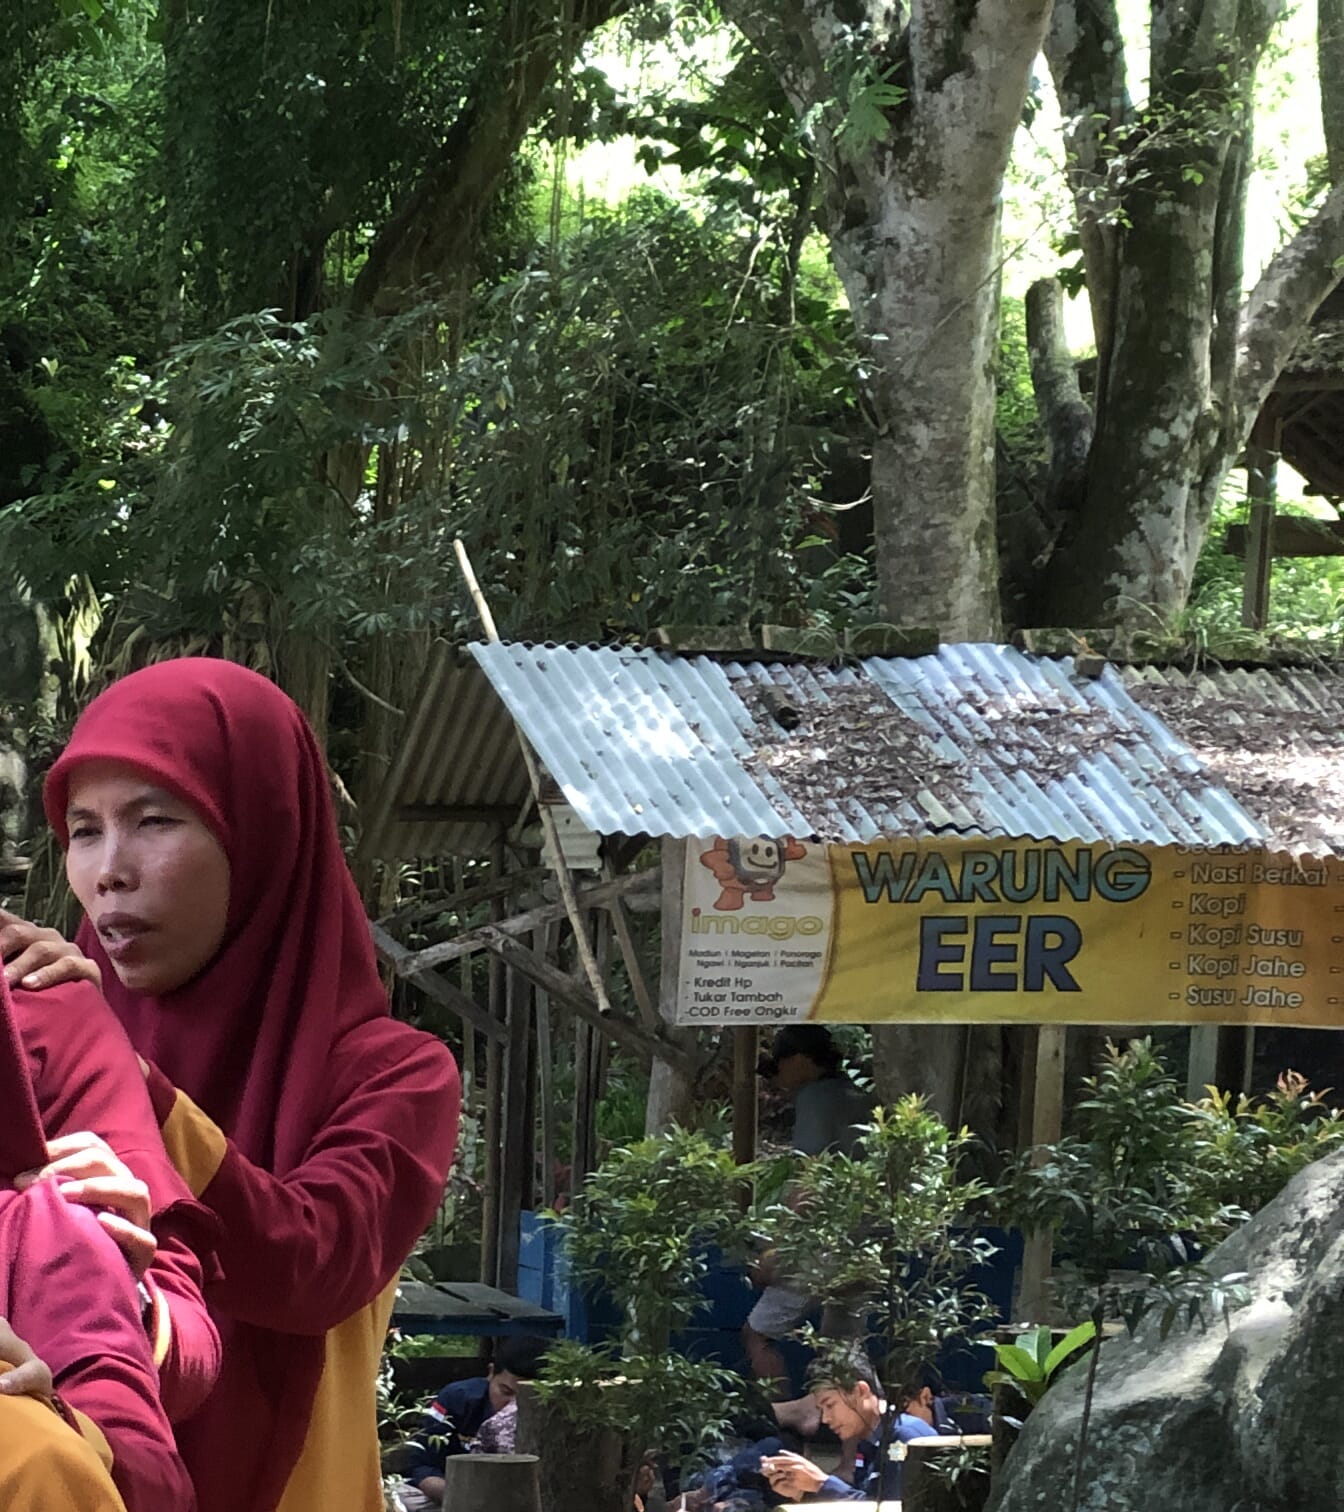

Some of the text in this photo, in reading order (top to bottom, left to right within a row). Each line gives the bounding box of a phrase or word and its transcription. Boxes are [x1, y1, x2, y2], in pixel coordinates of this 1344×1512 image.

[852, 848, 1151, 904] WARUNG
[1192, 863, 1245, 884] Nasi
[1189, 893, 1246, 919] Kopi
[690, 908, 823, 941] imago
[1188, 923, 1304, 949] Kopi Susu
[916, 915, 1082, 992] EER
[1187, 954, 1306, 979] Kopi Jahe
[694, 976, 752, 989] Kredit Hp
[694, 991, 783, 1002] Tukar Tambah
[1186, 985, 1304, 1008] Susu Jahe
[723, 1006, 750, 1017] Free
[754, 1005, 798, 1018] Ongkir
